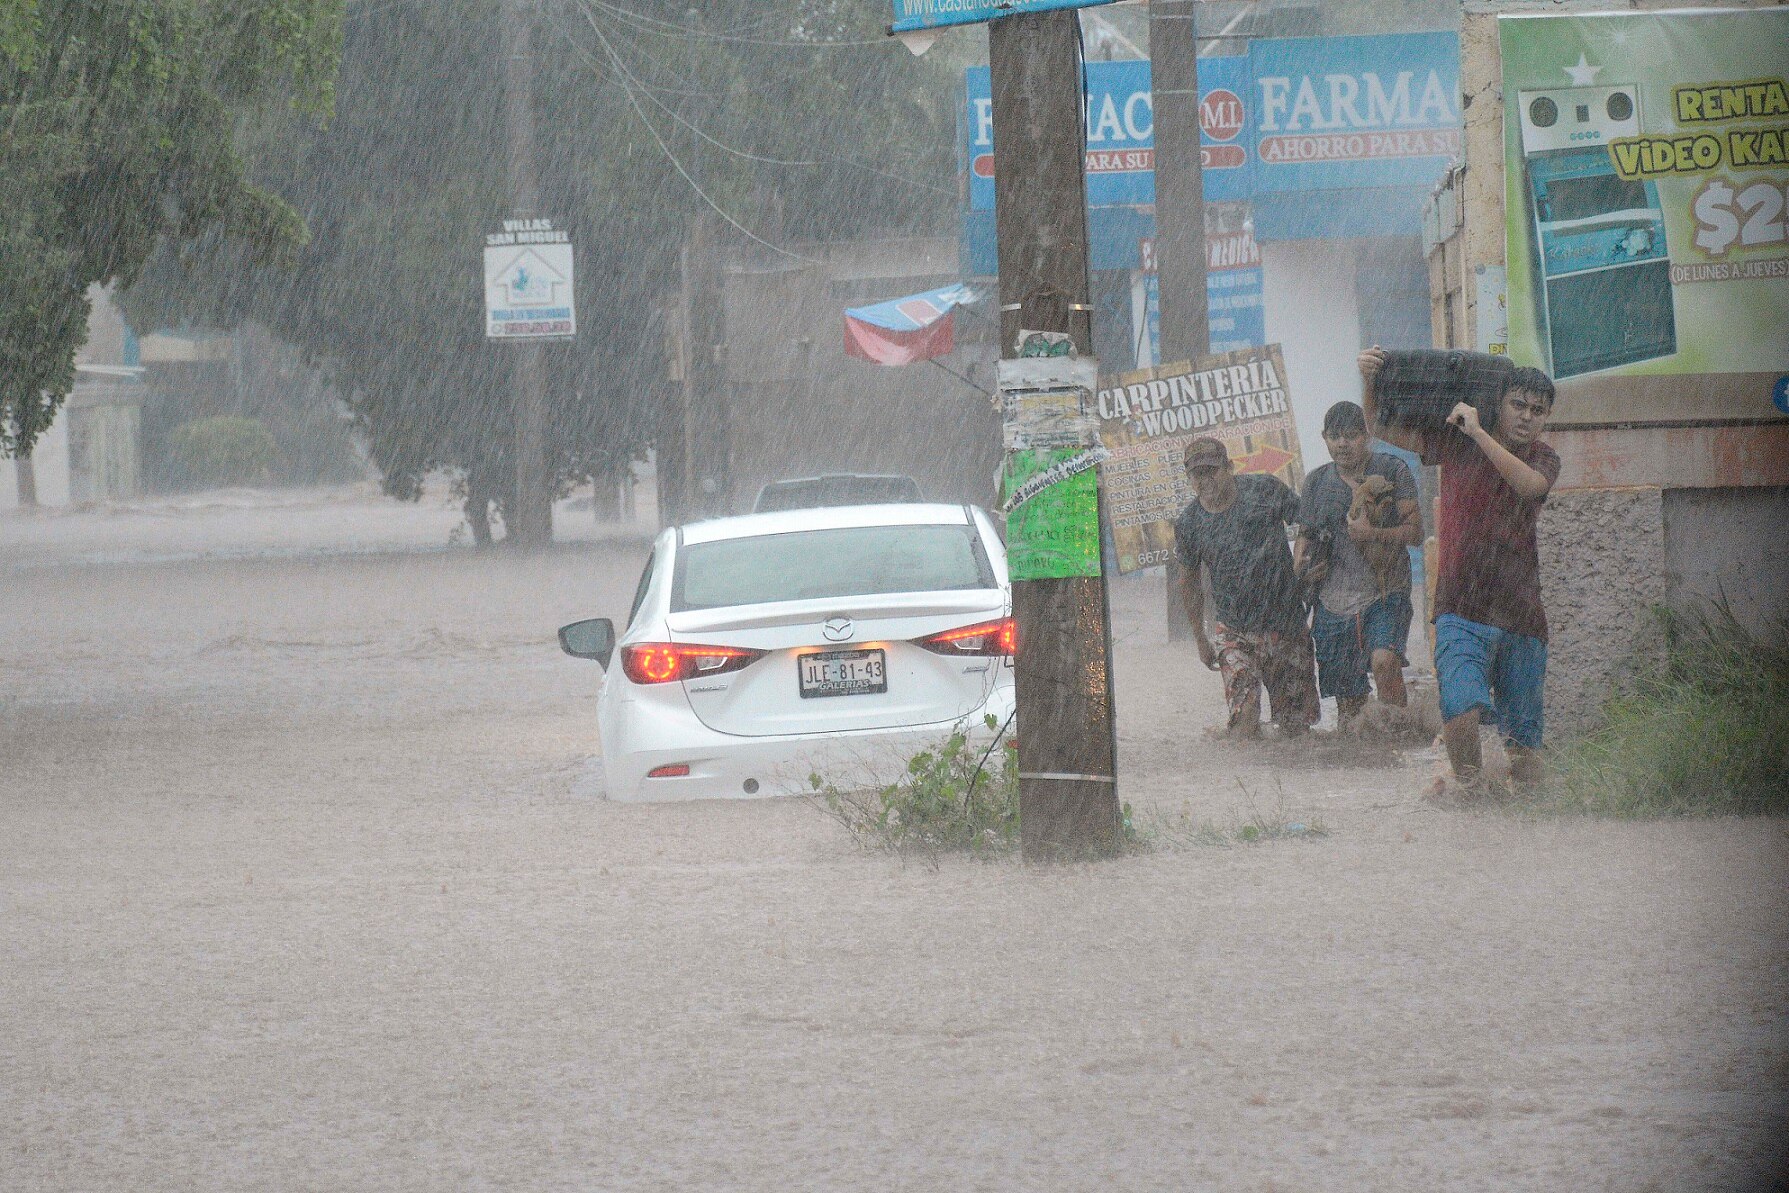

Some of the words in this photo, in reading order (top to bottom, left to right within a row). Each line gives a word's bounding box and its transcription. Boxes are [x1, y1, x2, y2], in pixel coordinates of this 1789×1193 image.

[1258, 68, 1460, 131] FARMA
[1677, 81, 1789, 122] RENTA
[1267, 136, 1364, 160] AHORRO
[1369, 132, 1431, 156] PARA
[1728, 129, 1789, 167] KA
[1126, 153, 1148, 169] SU
[503, 219, 551, 231] VILLAS
[1695, 180, 1789, 255] $2
[487, 233, 515, 245] SAN
[516, 231, 569, 243] MIGUEL
[1692, 264, 1729, 281] LUNES
[1732, 263, 1741, 278] A
[1098, 357, 1281, 420] CARPINTERÍA
[1142, 388, 1288, 437] WOODPECKER
[1109, 433, 1182, 460] ABRICACIÓN
[1105, 458, 1150, 473] MUEBLES
[1158, 452, 1184, 463] PUER
[1107, 472, 1152, 487] COCINAS
[1159, 465, 1186, 478] CLOS
[1109, 486, 1151, 501] PINTURA
[1111, 492, 1198, 514] RESTAURACIONES
[1115, 511, 1164, 527] PINTAMOS
[1137, 549, 1169, 565] 6672
[806, 661, 882, 684] JLE-81-43
[819, 679, 870, 690] GALERIAS
